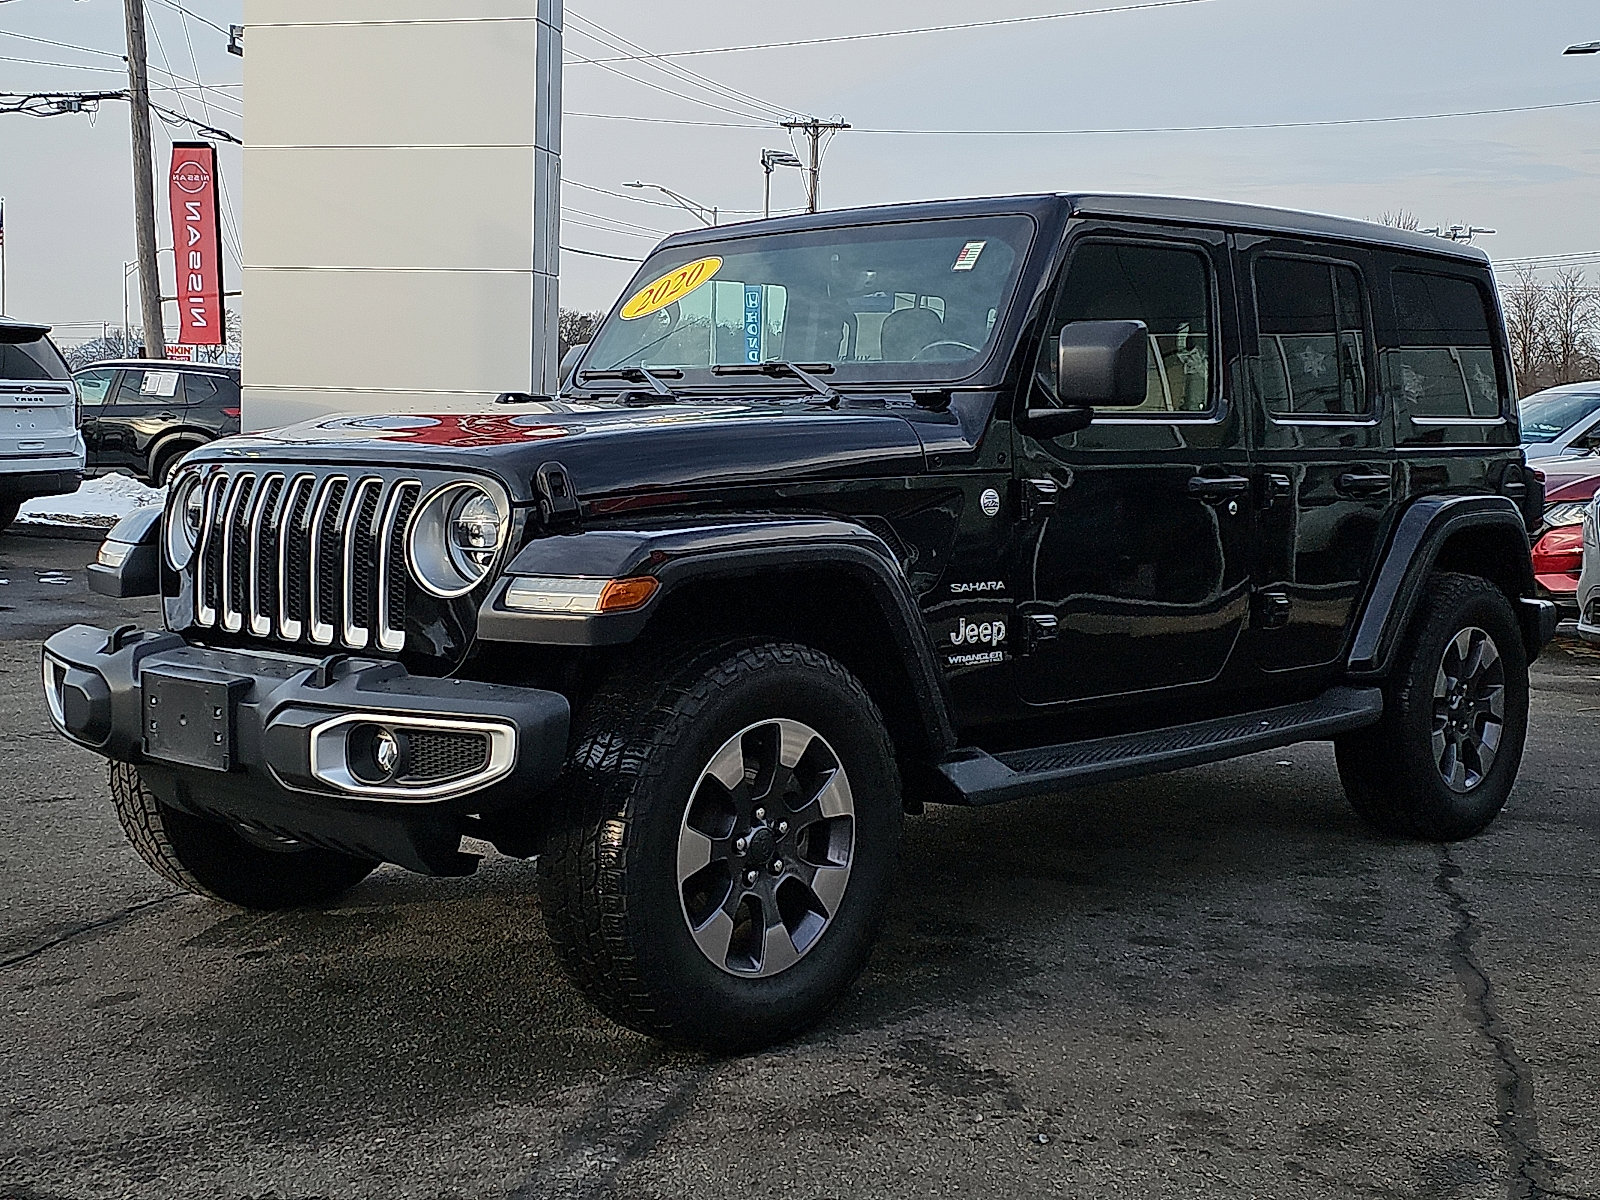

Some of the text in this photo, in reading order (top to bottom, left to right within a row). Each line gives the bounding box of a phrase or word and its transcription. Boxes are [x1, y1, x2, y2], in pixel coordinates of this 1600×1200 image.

[634, 262, 705, 315] 2020
[166, 345, 193, 355] NKIN'
[950, 581, 1006, 593] SAHARA
[950, 617, 1006, 647] Jeep
[948, 651, 1003, 664] WRANGLER
